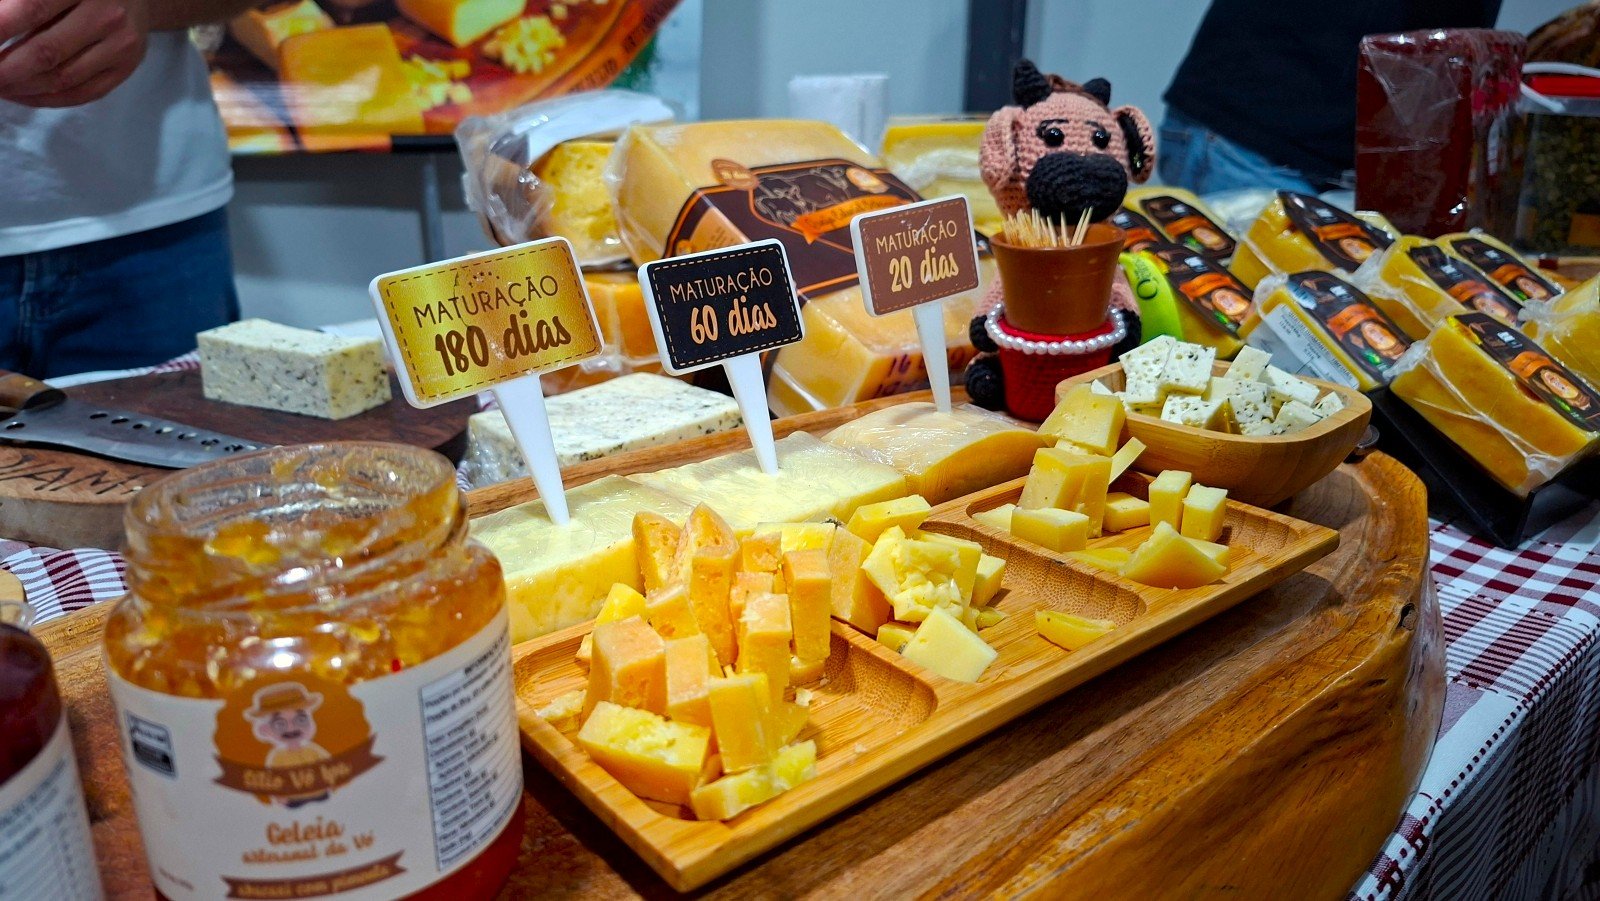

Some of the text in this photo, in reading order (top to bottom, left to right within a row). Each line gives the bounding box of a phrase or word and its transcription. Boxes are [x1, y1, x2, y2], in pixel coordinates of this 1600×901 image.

[875, 219, 958, 255] MATURAÇÃO
[669, 267, 773, 304] MATURAÇÃO
[888, 246, 959, 293] 20 dias
[412, 275, 559, 328] MATURAÇÃO
[690, 295, 777, 345] 60 dias
[435, 309, 571, 376] 180 dias
[266, 816, 344, 846] Geleia
